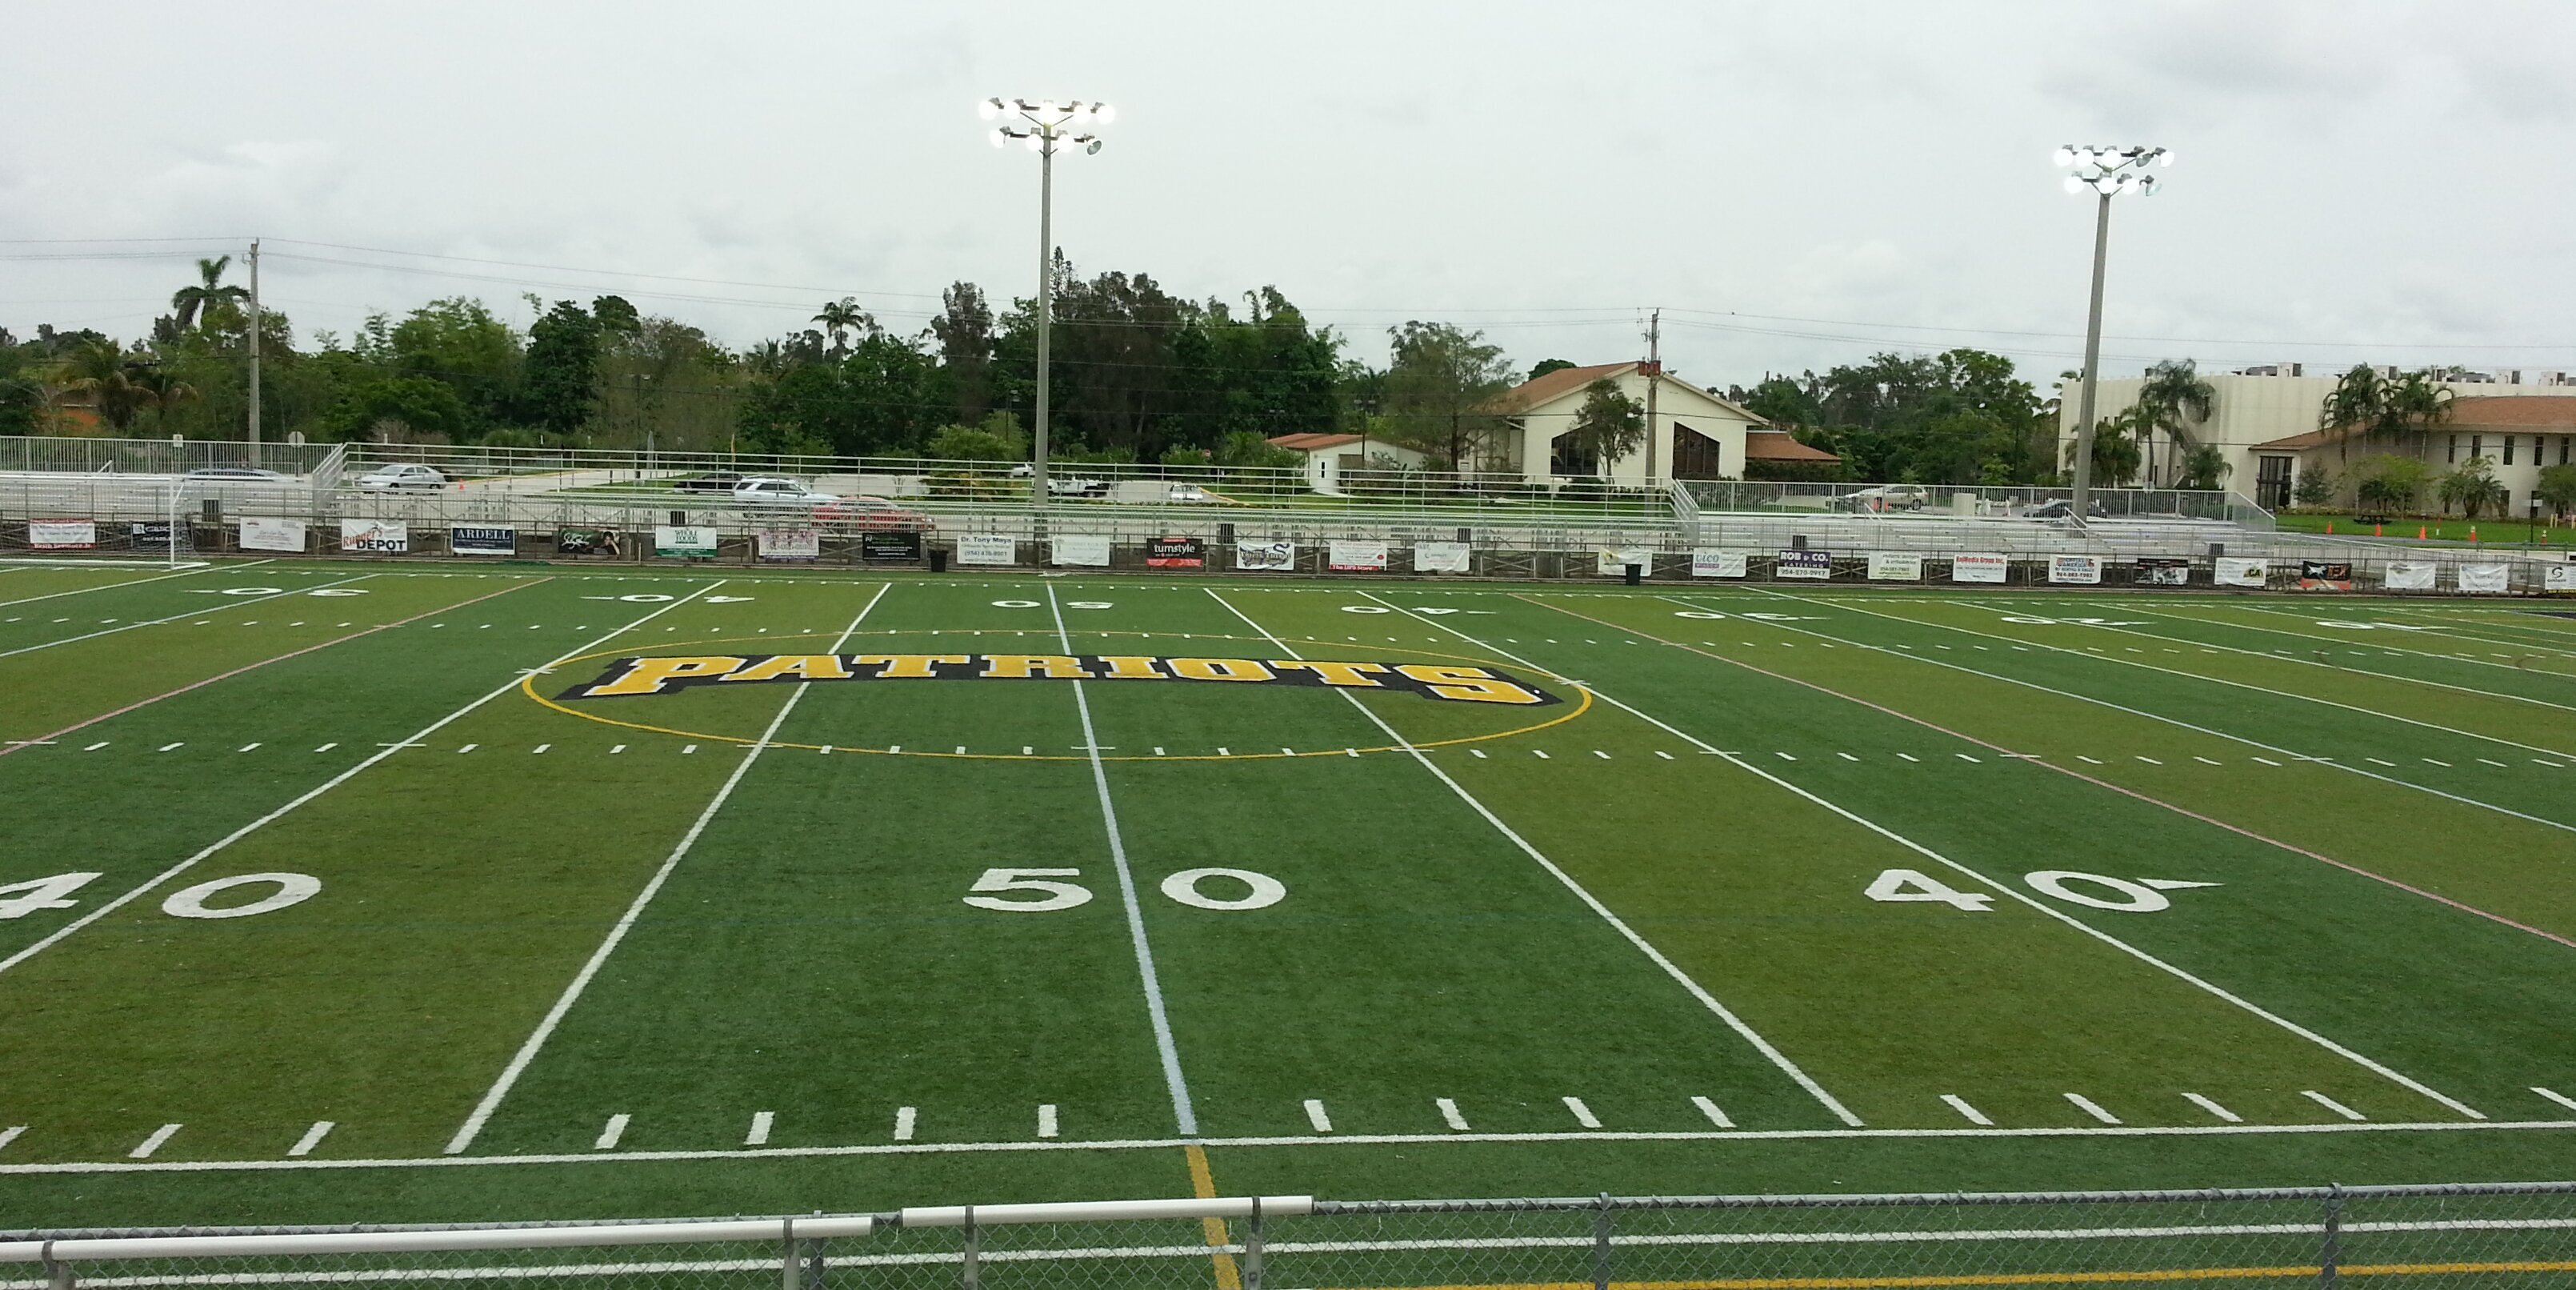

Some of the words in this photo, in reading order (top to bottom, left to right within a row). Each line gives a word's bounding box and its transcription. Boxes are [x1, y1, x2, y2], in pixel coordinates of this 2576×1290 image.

[342, 527, 384, 548] Runner's
[457, 528, 510, 540] ARDELL
[974, 536, 991, 544] Tony
[356, 539, 406, 551] DEPOT
[1154, 543, 1196, 555] turnstyle
[1780, 551, 1802, 561] ROB
[1811, 553, 1829, 562] CO.
[580, 654, 1542, 704] PATRIOTS
